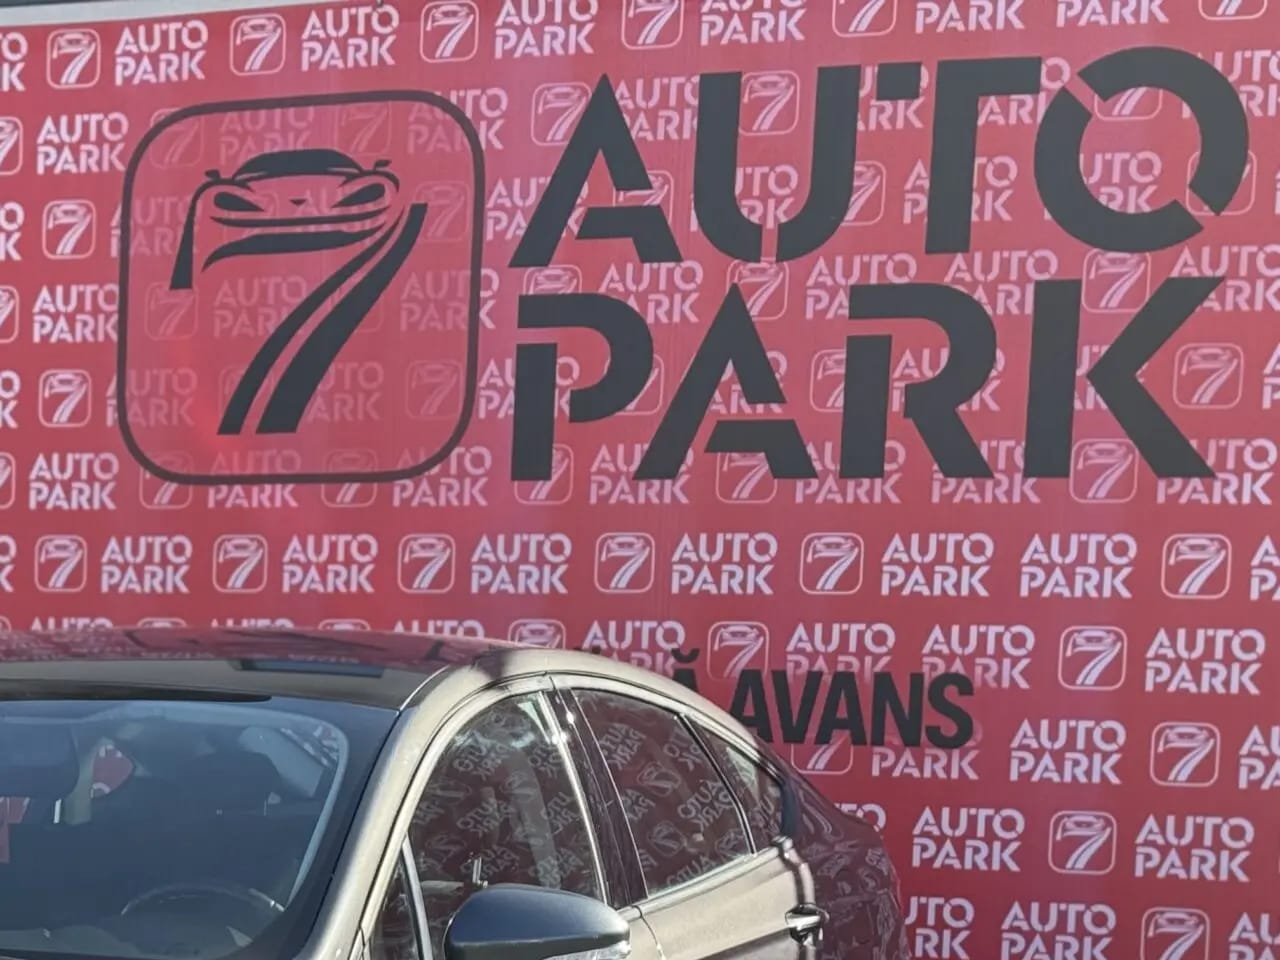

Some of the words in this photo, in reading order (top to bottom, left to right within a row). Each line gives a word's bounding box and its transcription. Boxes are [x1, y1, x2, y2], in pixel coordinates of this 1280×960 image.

[302, 5, 399, 39] AUTO
[495, 0, 598, 26] AUTO
[701, 9, 806, 46] PARK
[916, 0, 1025, 34] PARK
[1057, 0, 1170, 28] PARK
[116, 21, 207, 55] AUTO
[495, 25, 594, 59] PARK
[115, 53, 205, 86] PARK
[302, 38, 396, 71] PARK
[37, 112, 128, 144] AUTO
[37, 143, 125, 174] PARK
[508, 46, 1249, 267] AUTO
[1079, 151, 1162, 185] UTO
[598, 260, 703, 292] AUTO
[806, 253, 917, 287] AUTO
[944, 250, 1059, 283] AUTO
[510, 276, 1225, 480] PARK
[29, 453, 118, 480] AUTO
[29, 482, 115, 510] PARK
[208, 483, 299, 509] PARK
[393, 478, 488, 507] PARK
[591, 475, 690, 505] PARK
[796, 473, 902, 504] PARK
[932, 473, 1041, 504] PARK
[1157, 472, 1274, 505] PARK
[101, 536, 192, 563] AUTO
[283, 534, 377, 563] AUTO
[472, 534, 571, 563] AUTO
[672, 533, 777, 563] AUTO
[882, 533, 994, 564] AUTO
[1021, 533, 1137, 565] AUTO
[102, 565, 189, 593] PARK
[283, 564, 374, 593] PARK
[472, 564, 568, 594] PARK
[672, 564, 773, 594] PARK
[881, 565, 990, 596] PARK
[1020, 566, 1132, 598] PARK
[584, 621, 686, 652] AUTO
[786, 623, 896, 654] AUTO
[922, 624, 1036, 657] AUTO
[1146, 628, 1265, 661] AUTO
[1145, 661, 1261, 694] PARK
[730, 669, 974, 750] AVANS
[1011, 719, 1126, 751] AUTO
[872, 747, 979, 780] PARK
[1010, 751, 1121, 784] PARK
[913, 807, 1024, 839] AUTO
[1136, 815, 1254, 848] AUTO
[912, 838, 1021, 871] PARK
[1135, 846, 1250, 882] PARK
[1002, 901, 1116, 935] AUTO
